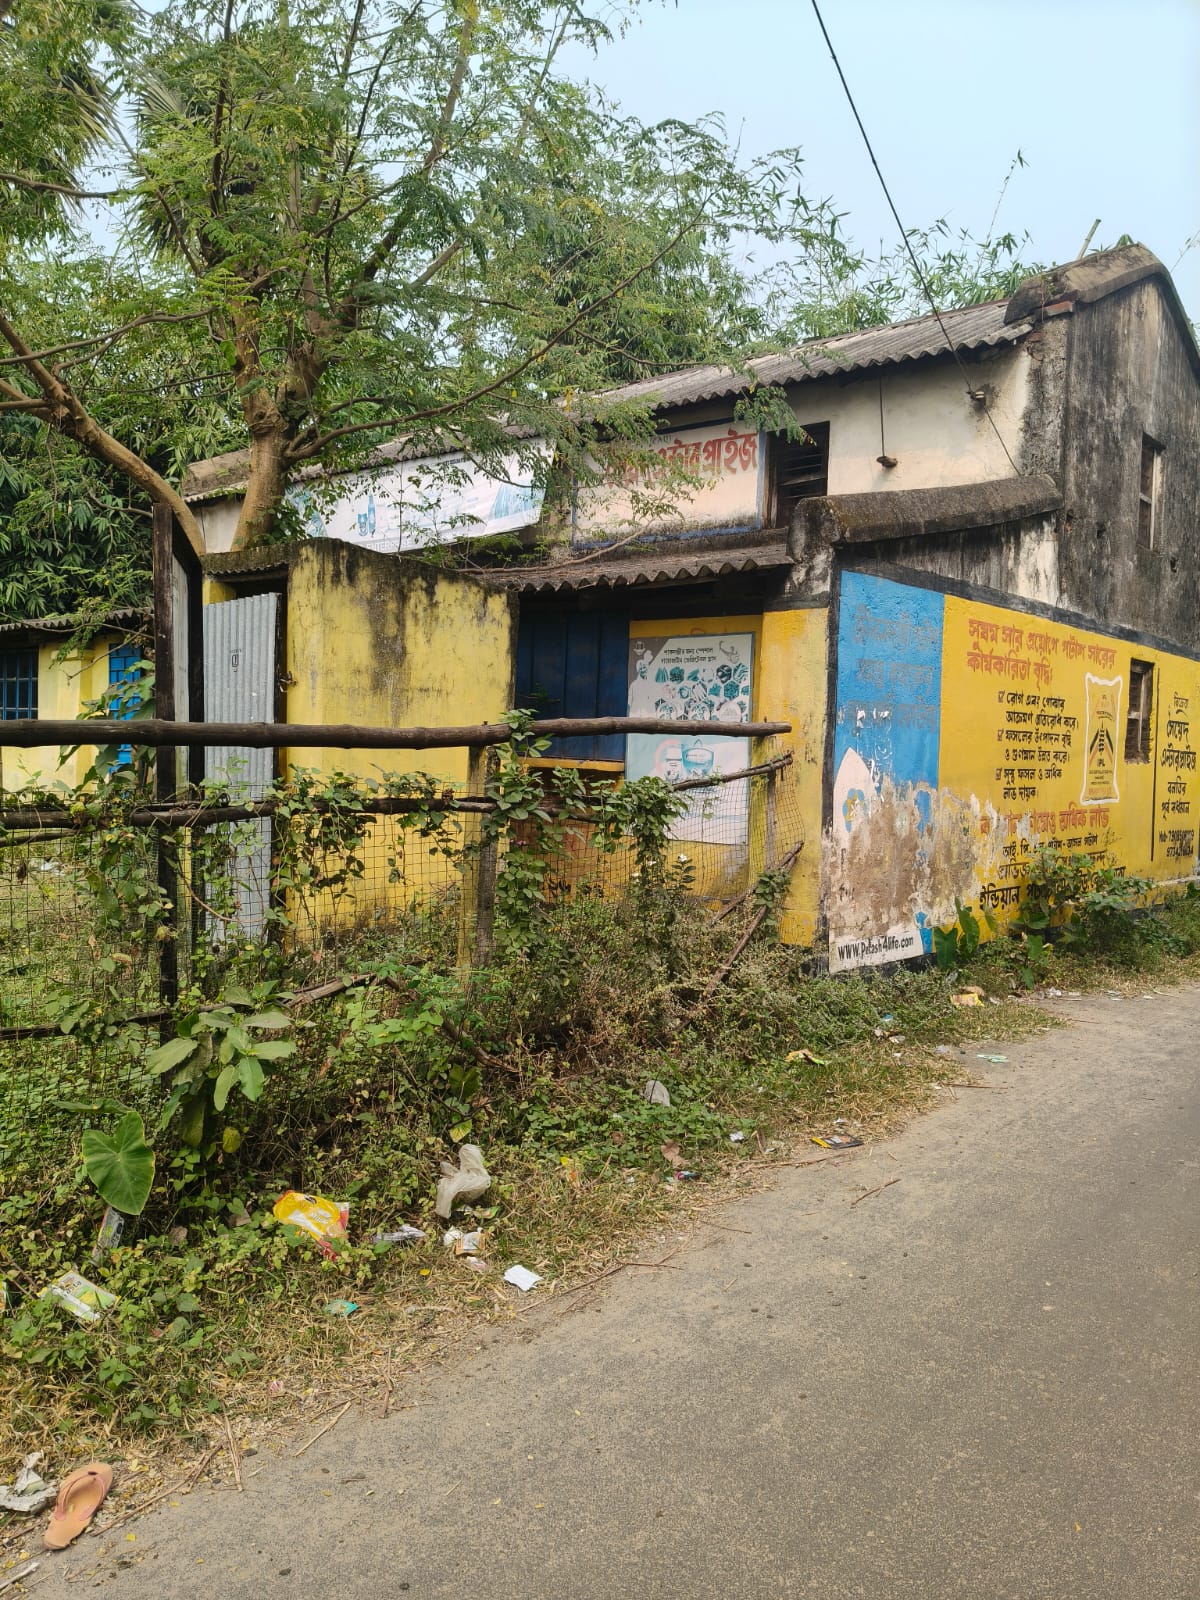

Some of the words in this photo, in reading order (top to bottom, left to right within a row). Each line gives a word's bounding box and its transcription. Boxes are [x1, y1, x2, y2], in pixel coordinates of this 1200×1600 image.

[1018, 768, 1036, 780] ফসল
[1003, 786, 1016, 800] লাভ
[1090, 805, 1110, 828] লাভ
